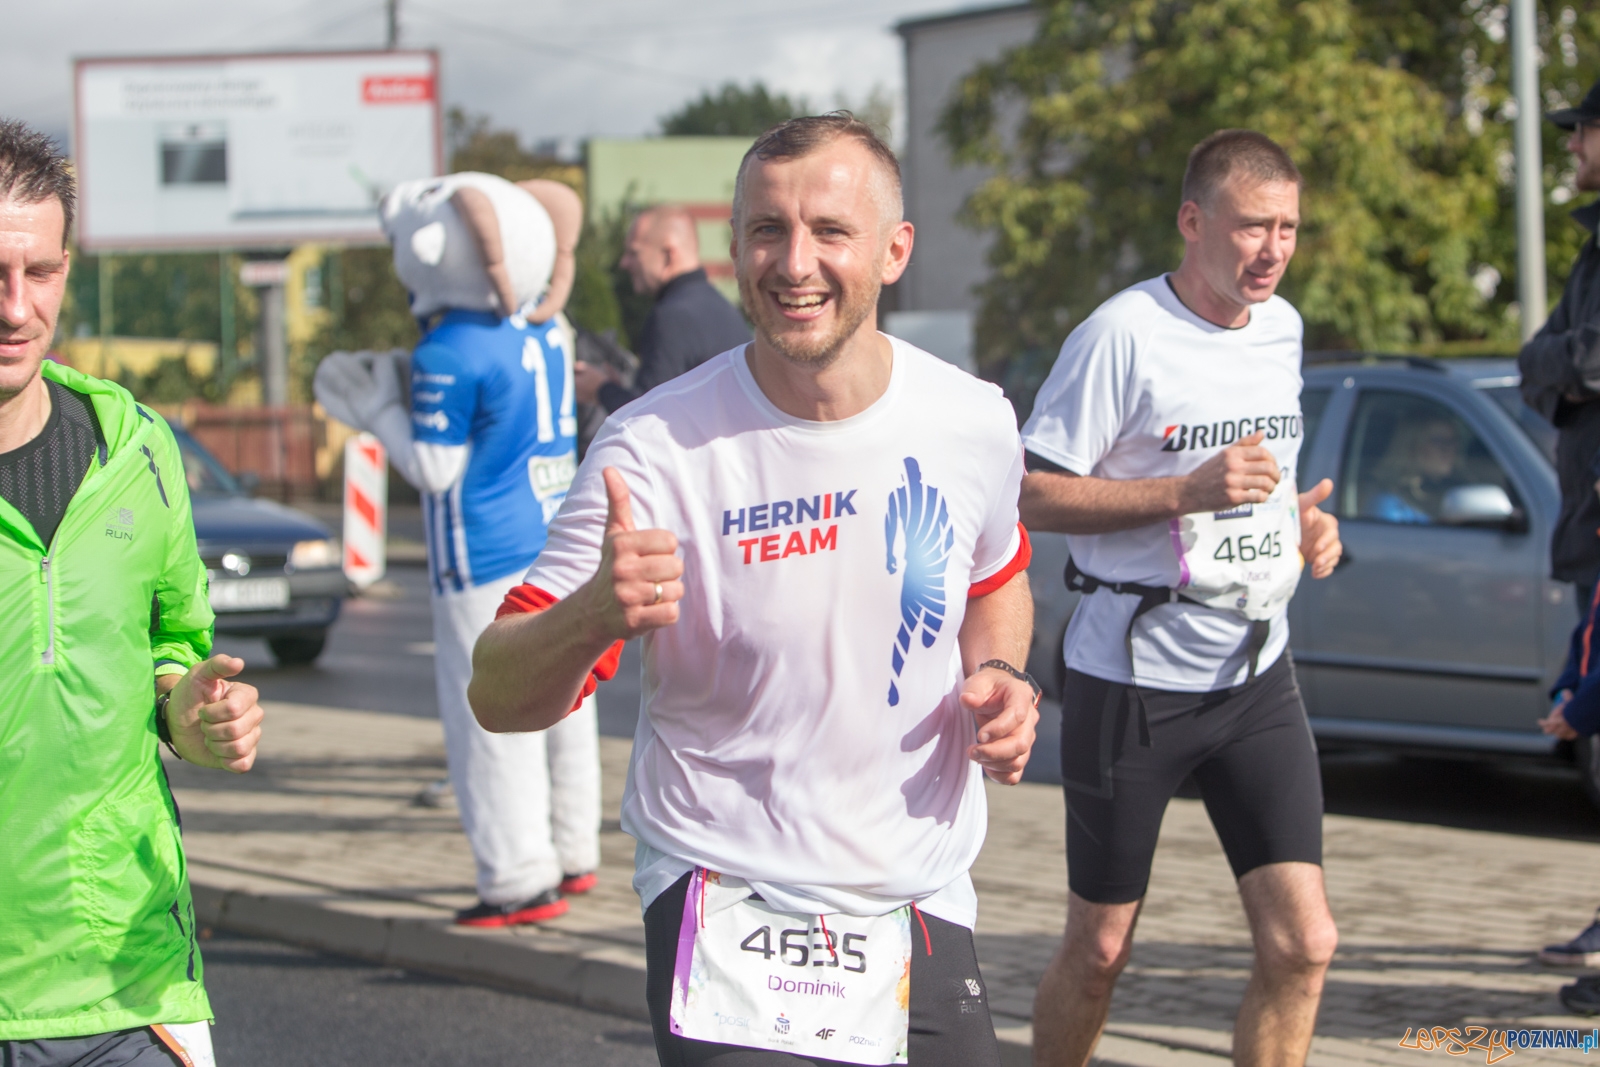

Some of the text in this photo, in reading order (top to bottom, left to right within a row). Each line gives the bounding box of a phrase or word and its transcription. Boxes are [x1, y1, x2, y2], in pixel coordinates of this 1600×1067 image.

[1161, 415, 1301, 452] BRIDGESTO
[722, 489, 858, 536] HERNIK
[105, 528, 134, 541] RUN
[737, 524, 838, 565] TEAM
[1213, 531, 1282, 563] 4645
[740, 925, 867, 974] 4635
[768, 975, 846, 999] Dominik
[815, 1028, 836, 1040] 4F
